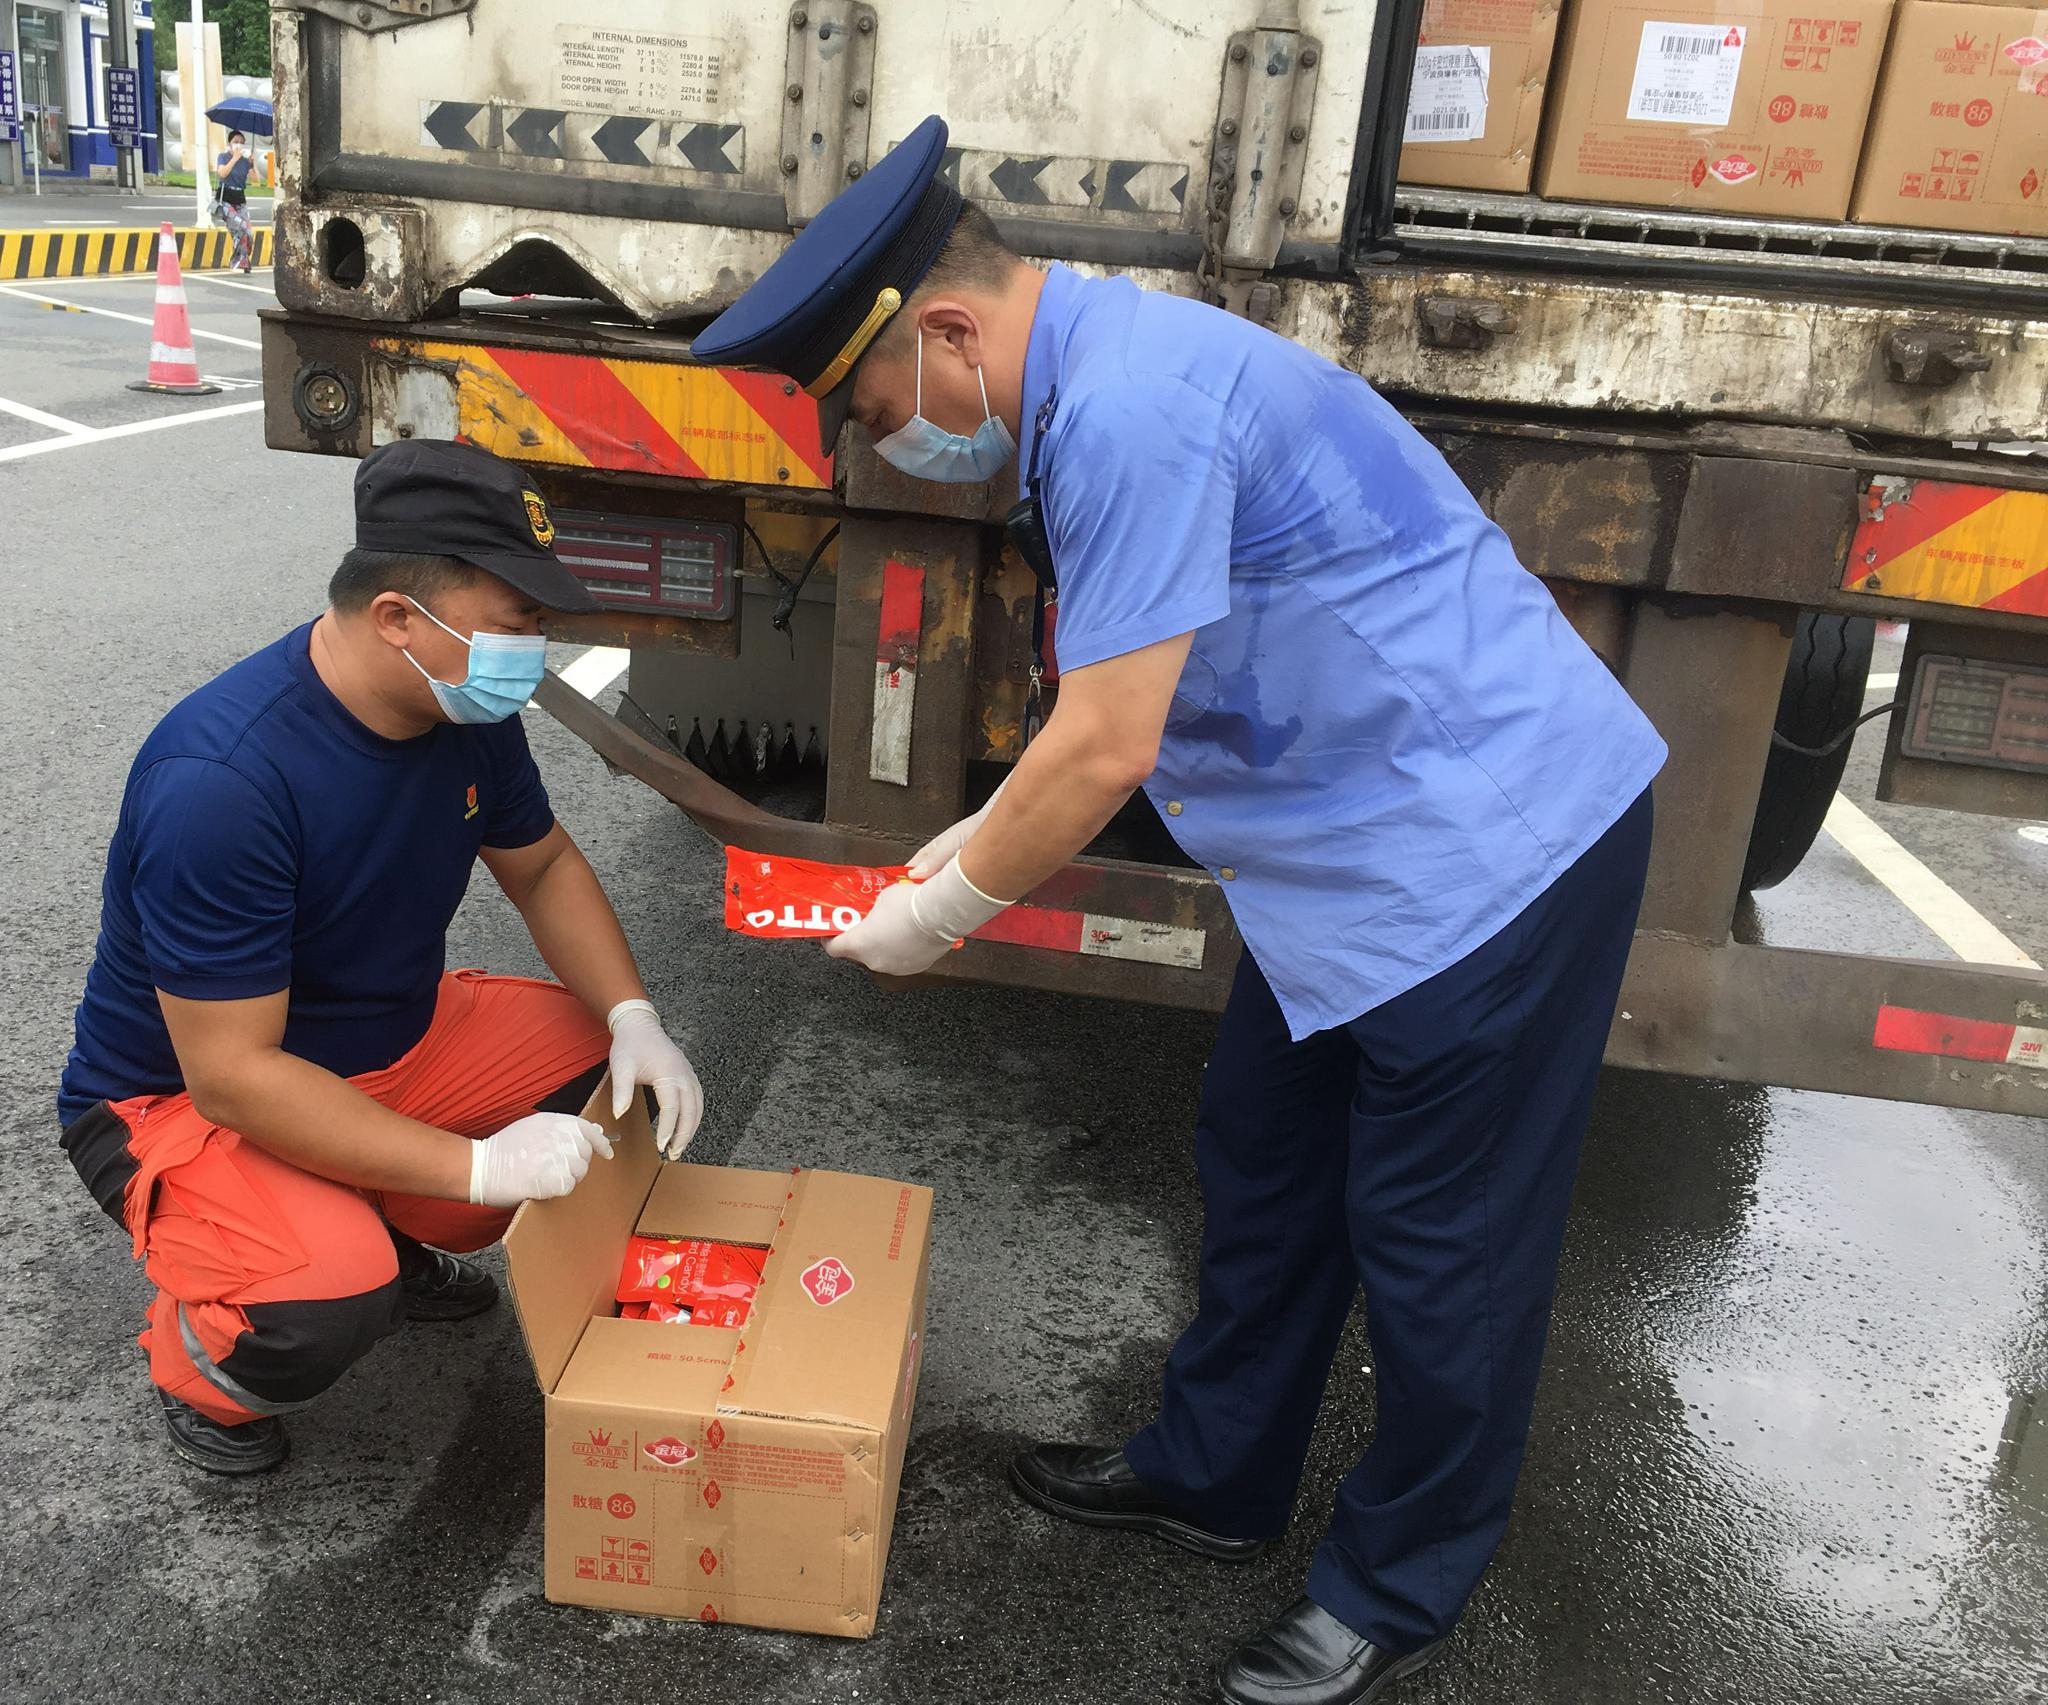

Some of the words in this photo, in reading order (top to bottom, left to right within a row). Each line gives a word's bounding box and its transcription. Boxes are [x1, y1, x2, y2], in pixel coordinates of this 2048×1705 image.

[592, 31, 633, 43] INTERNAL
[635, 35, 688, 48] DIMENSIONS
[597, 45, 625, 54] LENGTH
[708, 55, 720, 63] MM
[597, 54, 619, 62] WIDTH
[597, 62, 622, 70] HEIGHT
[561, 74, 581, 83] DOOR
[604, 78, 627, 87] WIDTH
[706, 88, 718, 96] MM
[561, 83, 581, 91] DOOR
[604, 87, 629, 96] HEIGHT
[1771, 101, 1793, 116] 86
[1930, 101, 1960, 118] 散糖
[1967, 105, 1989, 121] 86
[1718, 160, 1750, 174] 金冠
[2020, 1042, 2043, 1054] 3M
[677, 1256, 697, 1295] Candy
[815, 1265, 842, 1299] 金冠
[654, 1444, 688, 1458] 金冠
[572, 1494, 603, 1511] 散糖
[611, 1499, 635, 1514] 86
